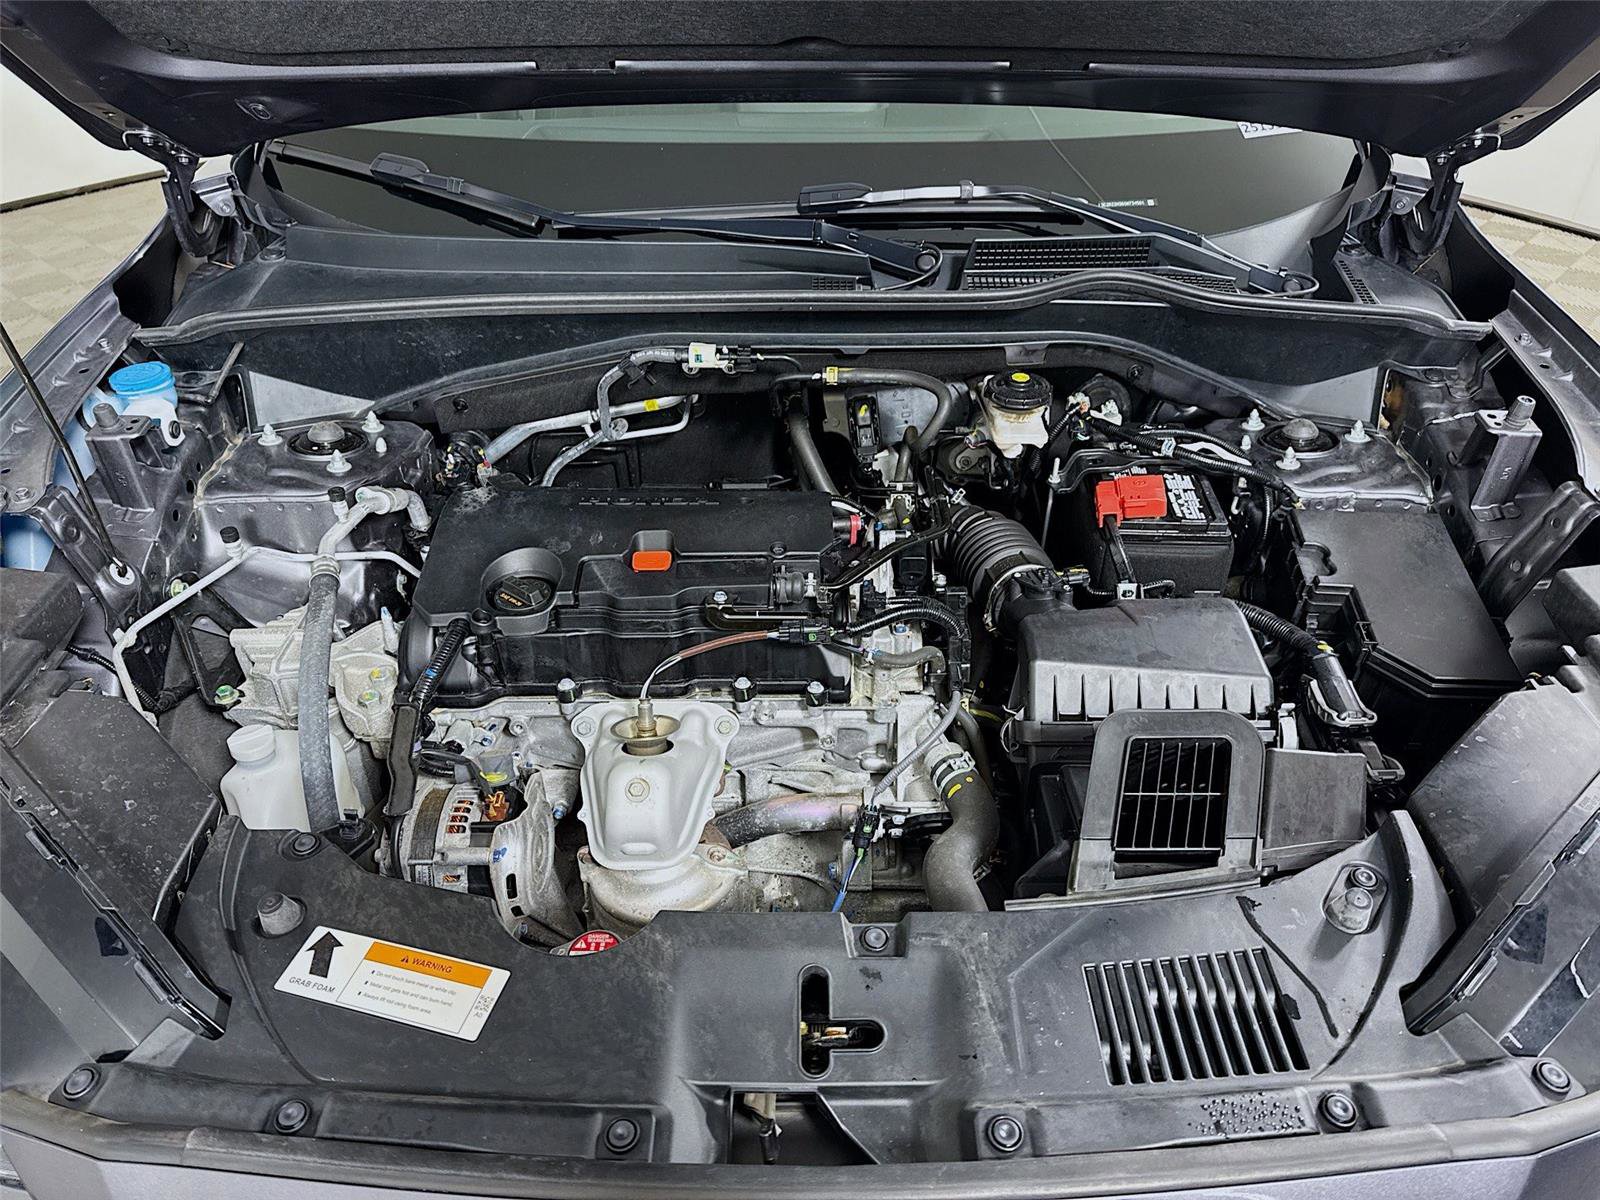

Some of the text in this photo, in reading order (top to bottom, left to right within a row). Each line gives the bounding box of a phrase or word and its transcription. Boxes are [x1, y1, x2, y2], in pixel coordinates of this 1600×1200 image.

[578, 496, 720, 506] HONDA
[412, 957, 453, 974] WARNING
[289, 976, 336, 993] GRAB FOAM
